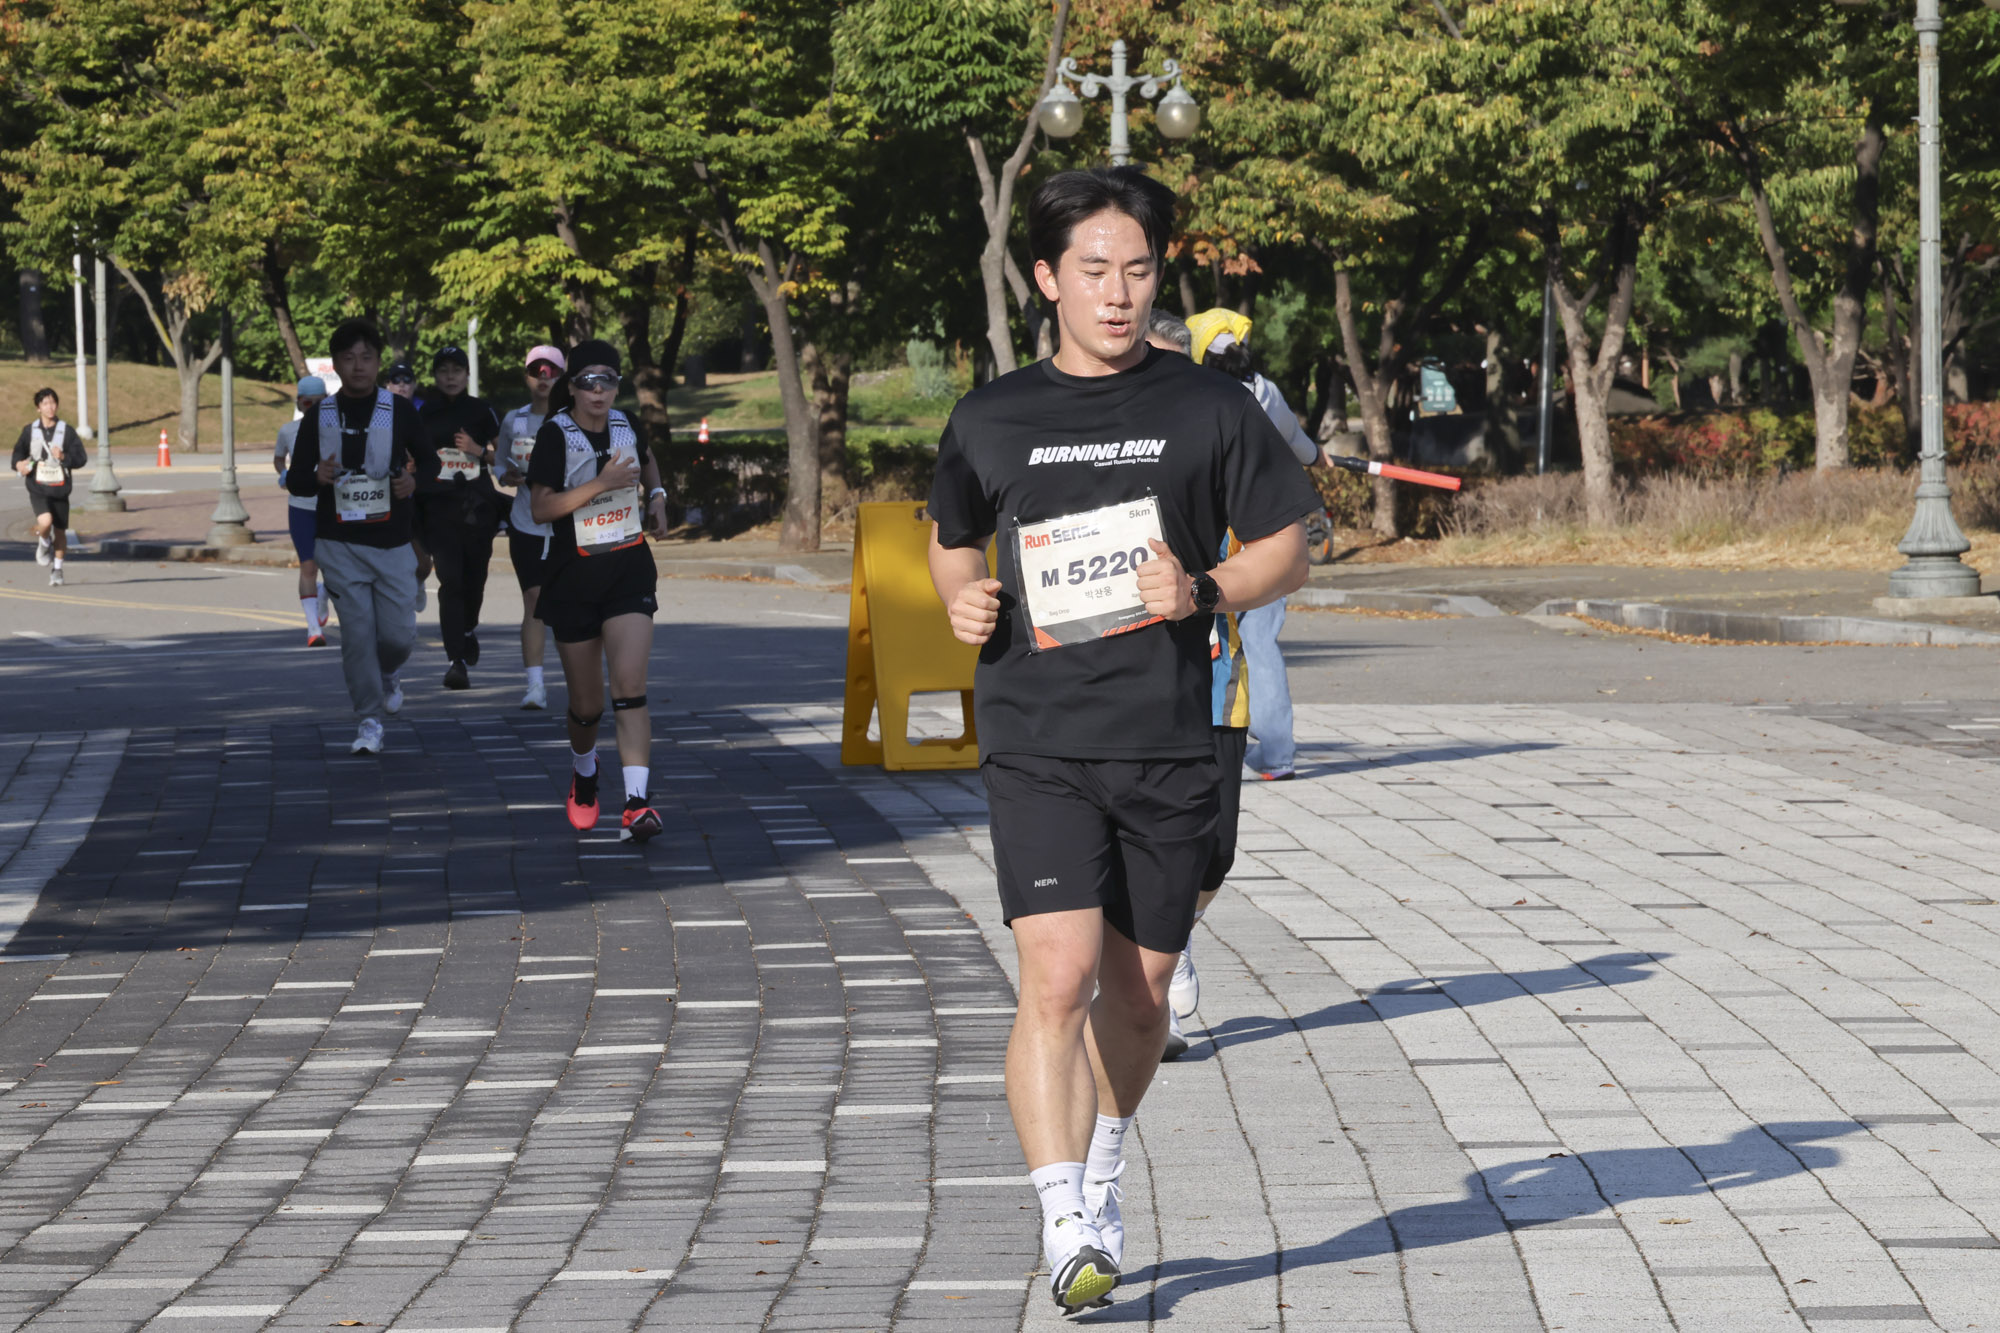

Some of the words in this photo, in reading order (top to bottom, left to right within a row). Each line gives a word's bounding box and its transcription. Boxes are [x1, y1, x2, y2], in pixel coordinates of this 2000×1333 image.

[1028, 442, 1120, 466] BURNING
[1120, 439, 1167, 458] RUN
[352, 489, 384, 501] 5026
[583, 516, 594, 527] W
[596, 505, 632, 526] 6287
[1129, 508, 1151, 519] 5km
[1041, 568, 1060, 588] M
[1067, 546, 1149, 586] 5220
